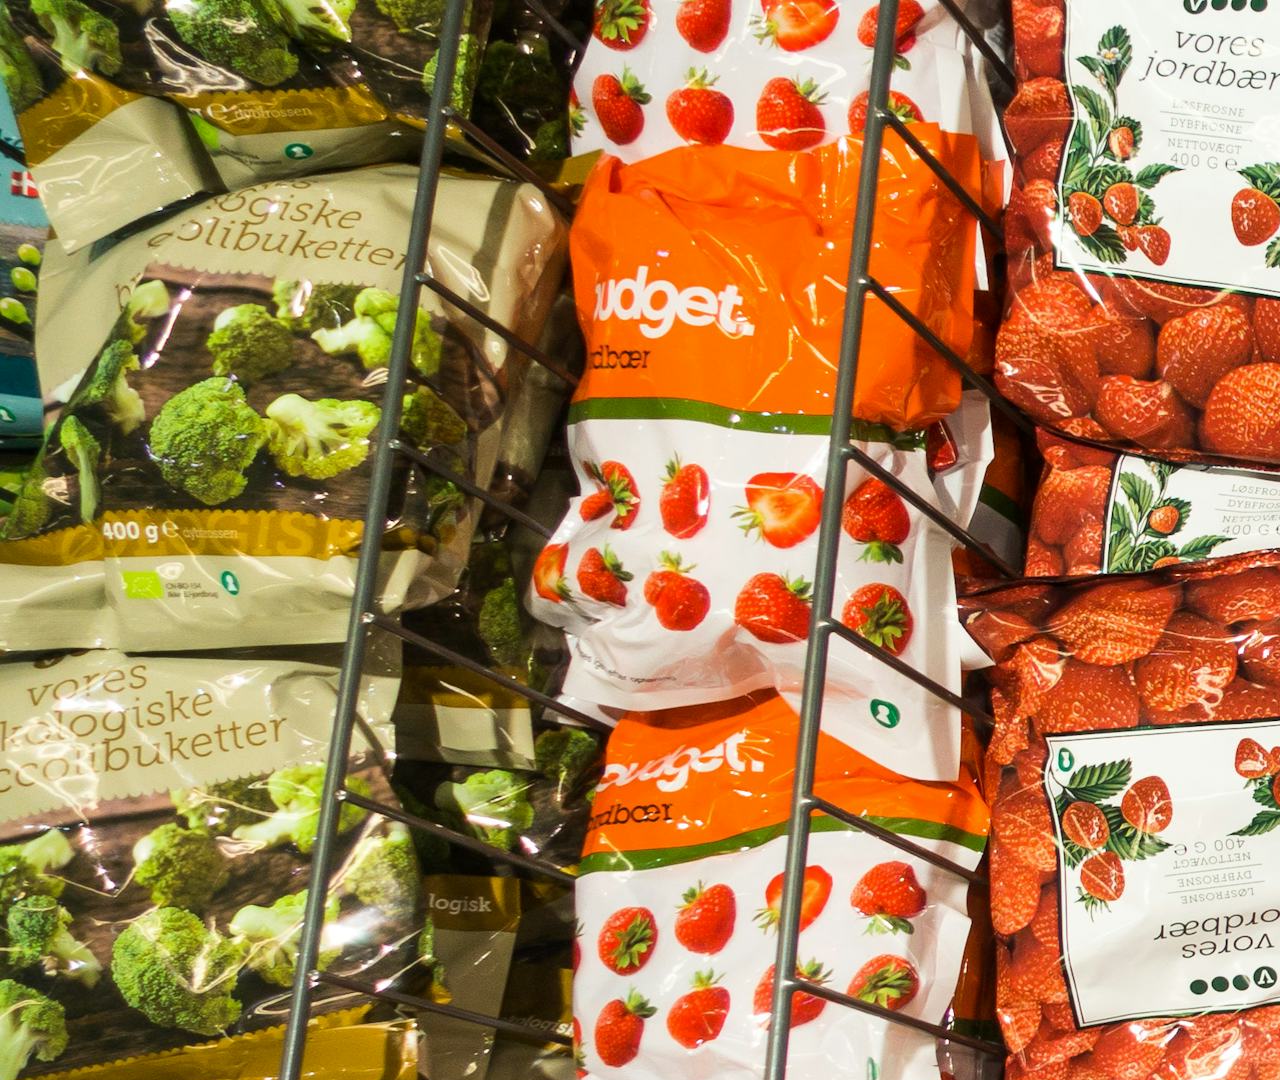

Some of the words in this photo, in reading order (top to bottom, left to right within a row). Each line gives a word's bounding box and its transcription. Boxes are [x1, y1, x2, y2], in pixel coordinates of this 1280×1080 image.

[1175, 30, 1265, 57] vores
[1168, 138, 1241, 155] NETTOVÆGT
[1170, 153, 1199, 167] 400
[103, 521, 140, 541] 400
[1222, 524, 1251, 536] 400
[27, 665, 147, 706] vores
[1215, 838, 1245, 851] 400
[1173, 852, 1250, 869] NETTOVÆGT
[1177, 871, 1252, 887] DYBFROSNE
[1181, 888, 1254, 904] LØSFROSNE
[1181, 934, 1275, 959] vores
